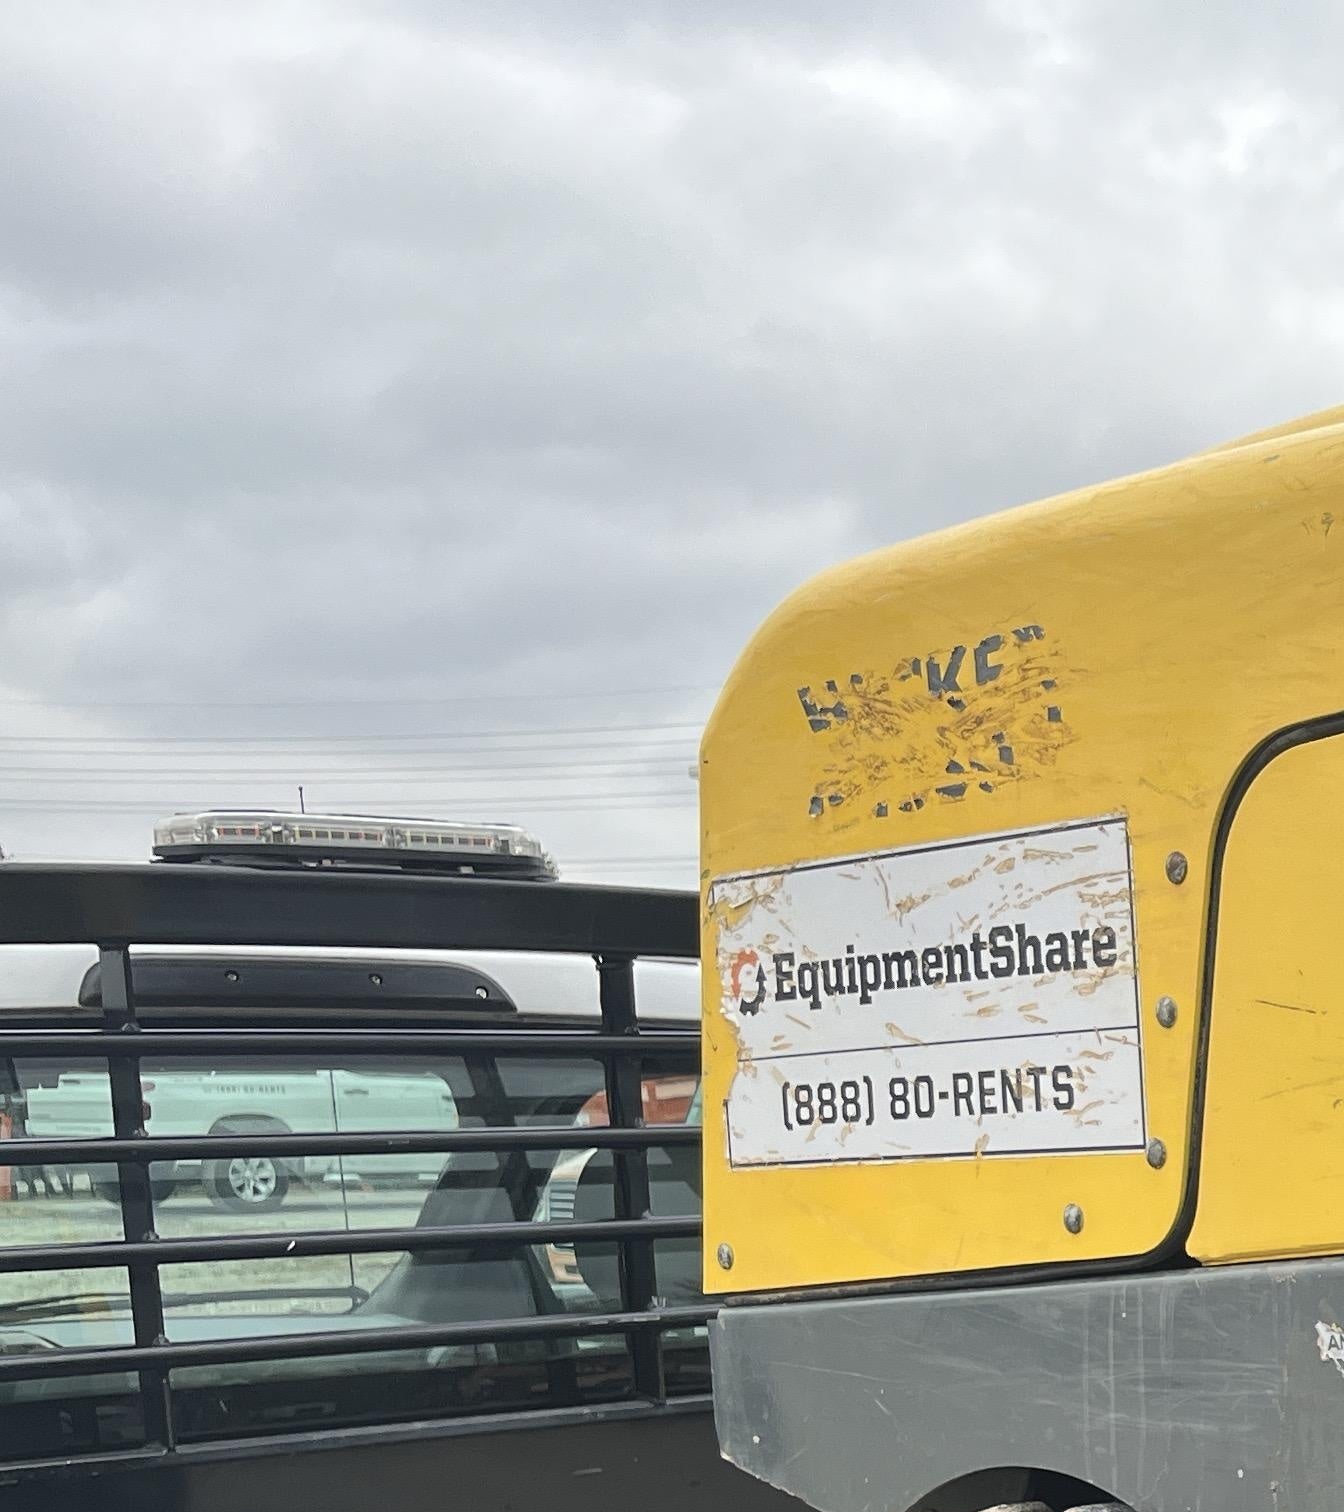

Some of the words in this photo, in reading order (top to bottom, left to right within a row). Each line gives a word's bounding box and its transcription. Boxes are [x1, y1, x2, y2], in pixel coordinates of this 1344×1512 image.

[772, 923, 1118, 1010] EquipmentShare
[782, 1076, 875, 1132] (888)
[888, 1065, 1075, 1119] 80-RENTS
